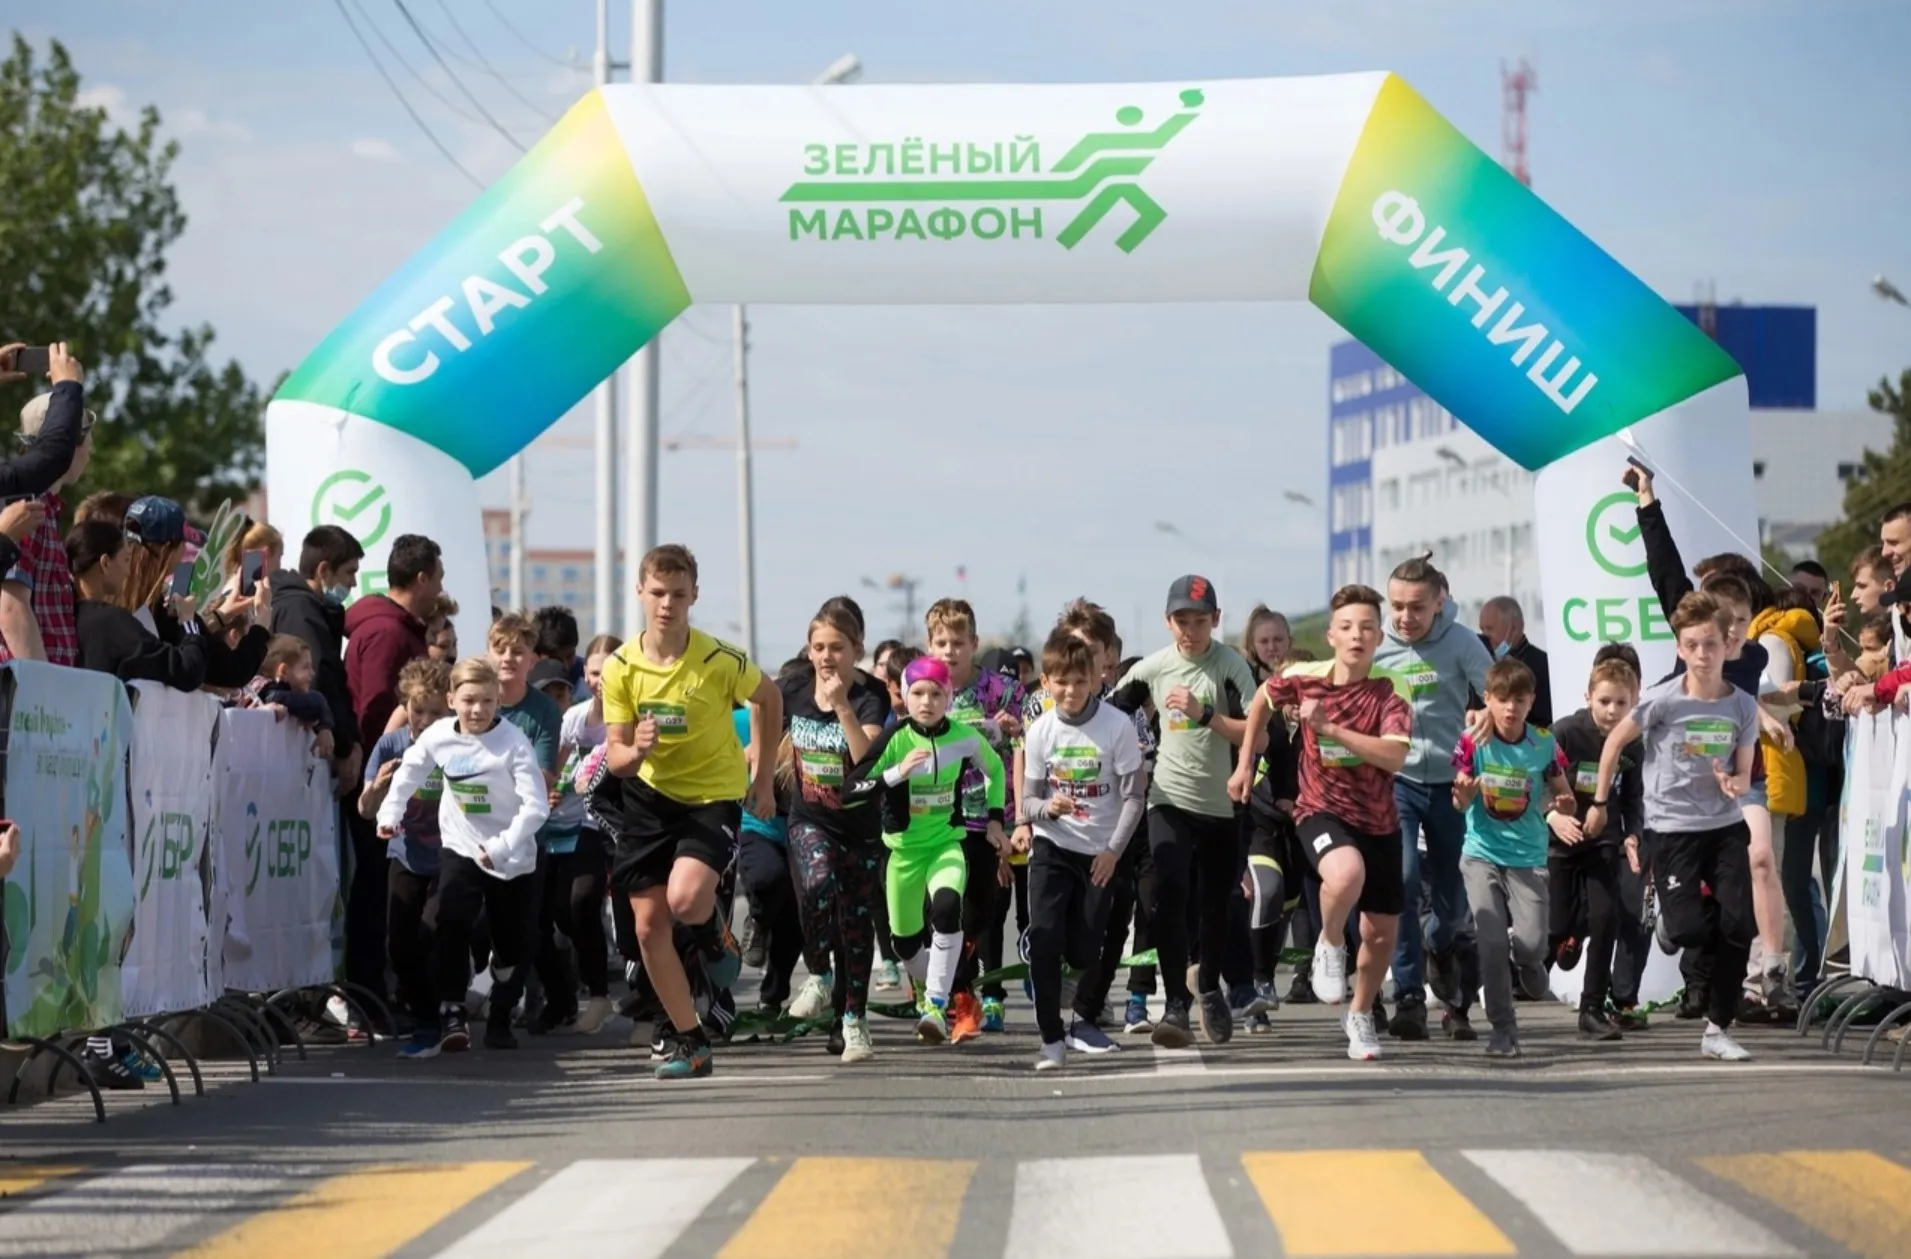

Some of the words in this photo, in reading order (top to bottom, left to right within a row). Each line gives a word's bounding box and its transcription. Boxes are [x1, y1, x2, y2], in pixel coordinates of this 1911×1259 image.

[803, 135, 1040, 176] ЗЕЛЁНЫЙ
[788, 206, 1043, 241] МАРАФОН
[371, 196, 604, 385] СТАРТ
[1371, 190, 1599, 415] ФИНИШ
[1562, 597, 1675, 642] СБЕ
